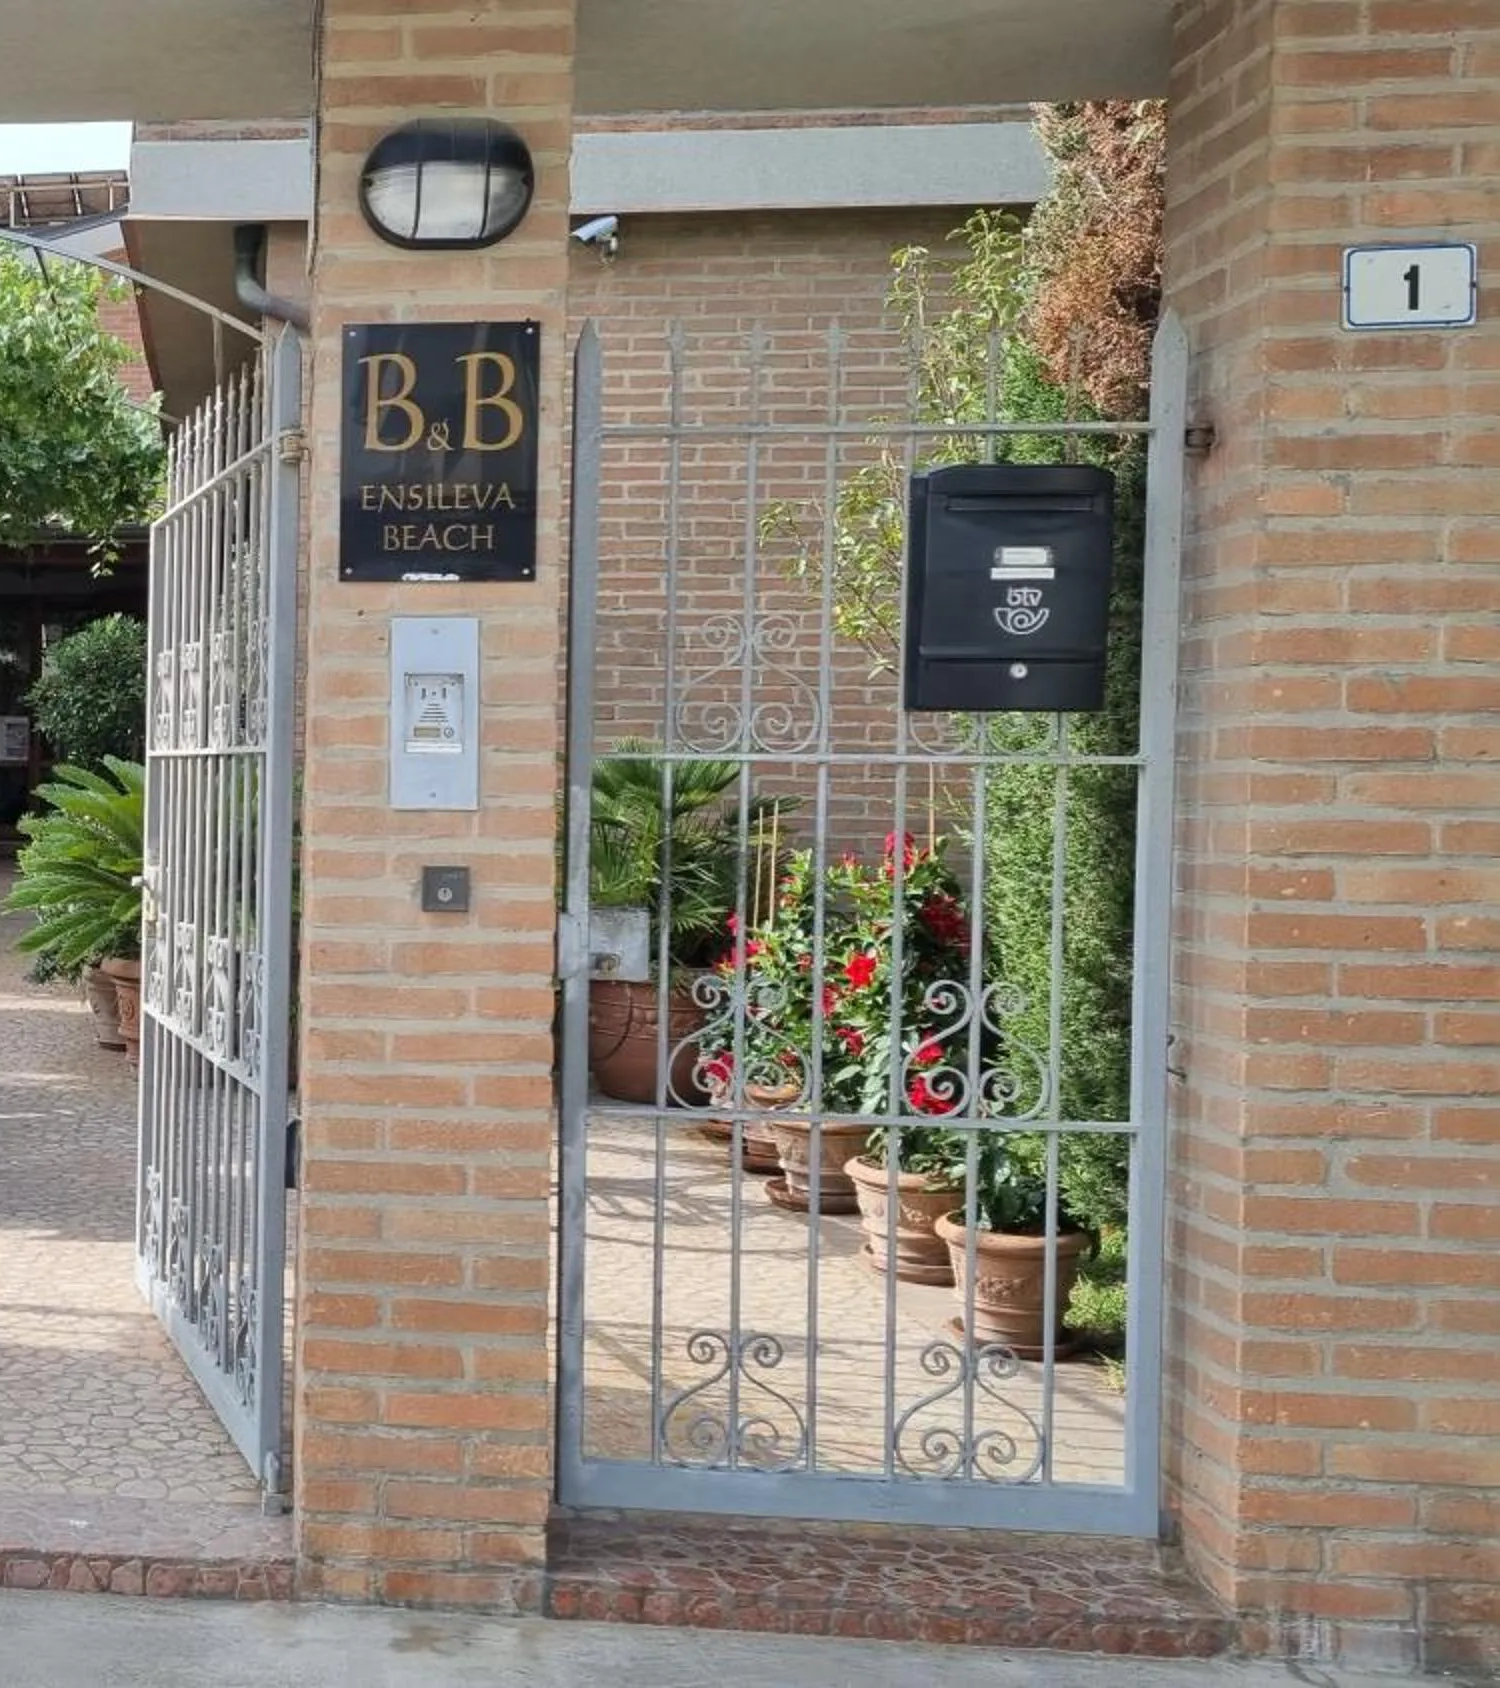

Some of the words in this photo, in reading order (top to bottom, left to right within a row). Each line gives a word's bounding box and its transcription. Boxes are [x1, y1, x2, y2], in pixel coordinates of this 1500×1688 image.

[1403, 264, 1420, 310] 1
[357, 352, 523, 451] B&B
[360, 483, 516, 512] ENSILEVA
[383, 523, 494, 550] BEACH
